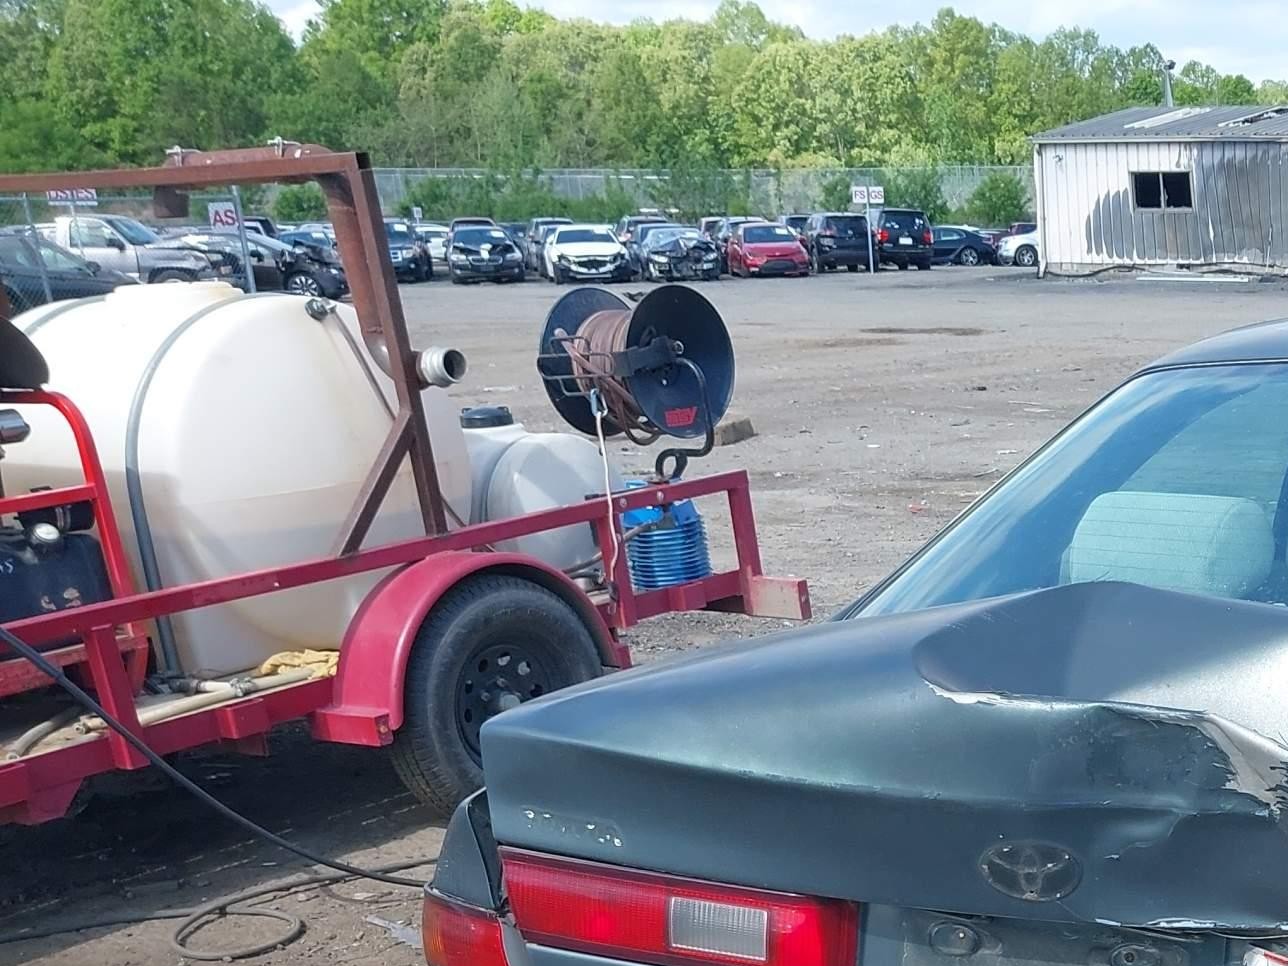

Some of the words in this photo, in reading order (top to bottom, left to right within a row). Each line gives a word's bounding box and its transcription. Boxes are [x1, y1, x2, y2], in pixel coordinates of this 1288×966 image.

[854, 190, 866, 200] FS
[870, 190, 883, 200] GS
[212, 208, 236, 227] AS
